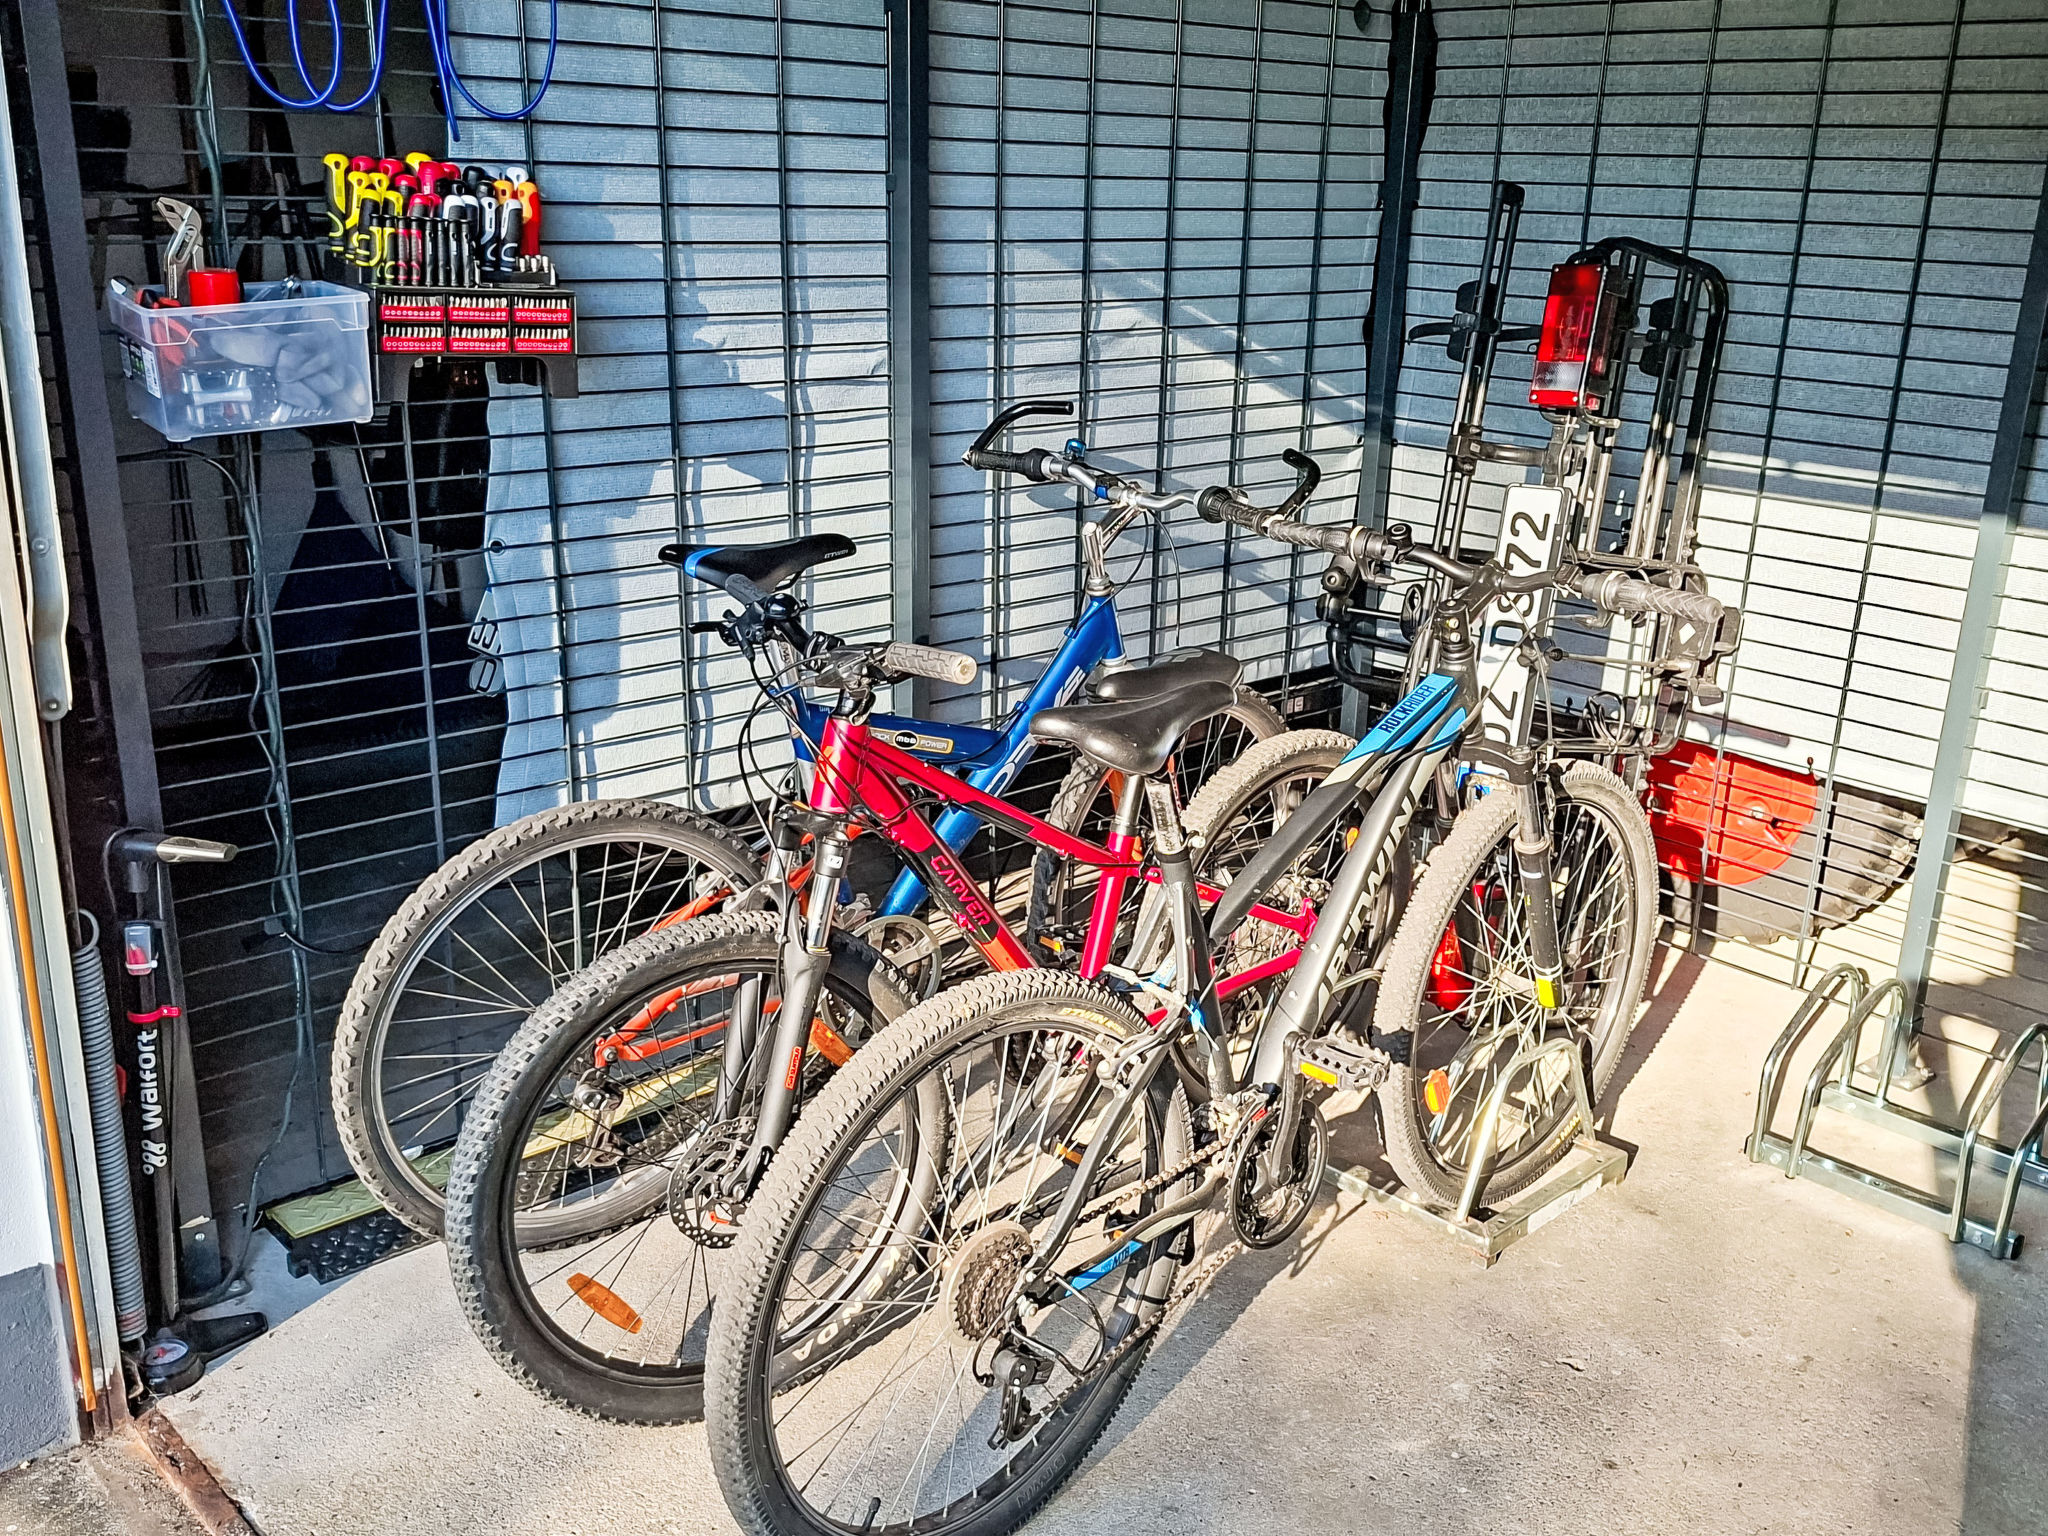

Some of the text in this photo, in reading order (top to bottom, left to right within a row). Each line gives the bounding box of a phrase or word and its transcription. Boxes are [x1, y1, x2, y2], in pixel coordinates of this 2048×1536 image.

[1503, 511, 1550, 571] 72
[1377, 684, 1437, 734] ROCKRIDER
[930, 854, 992, 926] CARVER
[137, 1028, 163, 1132] Walfort
[791, 1243, 902, 1362] KENDA
